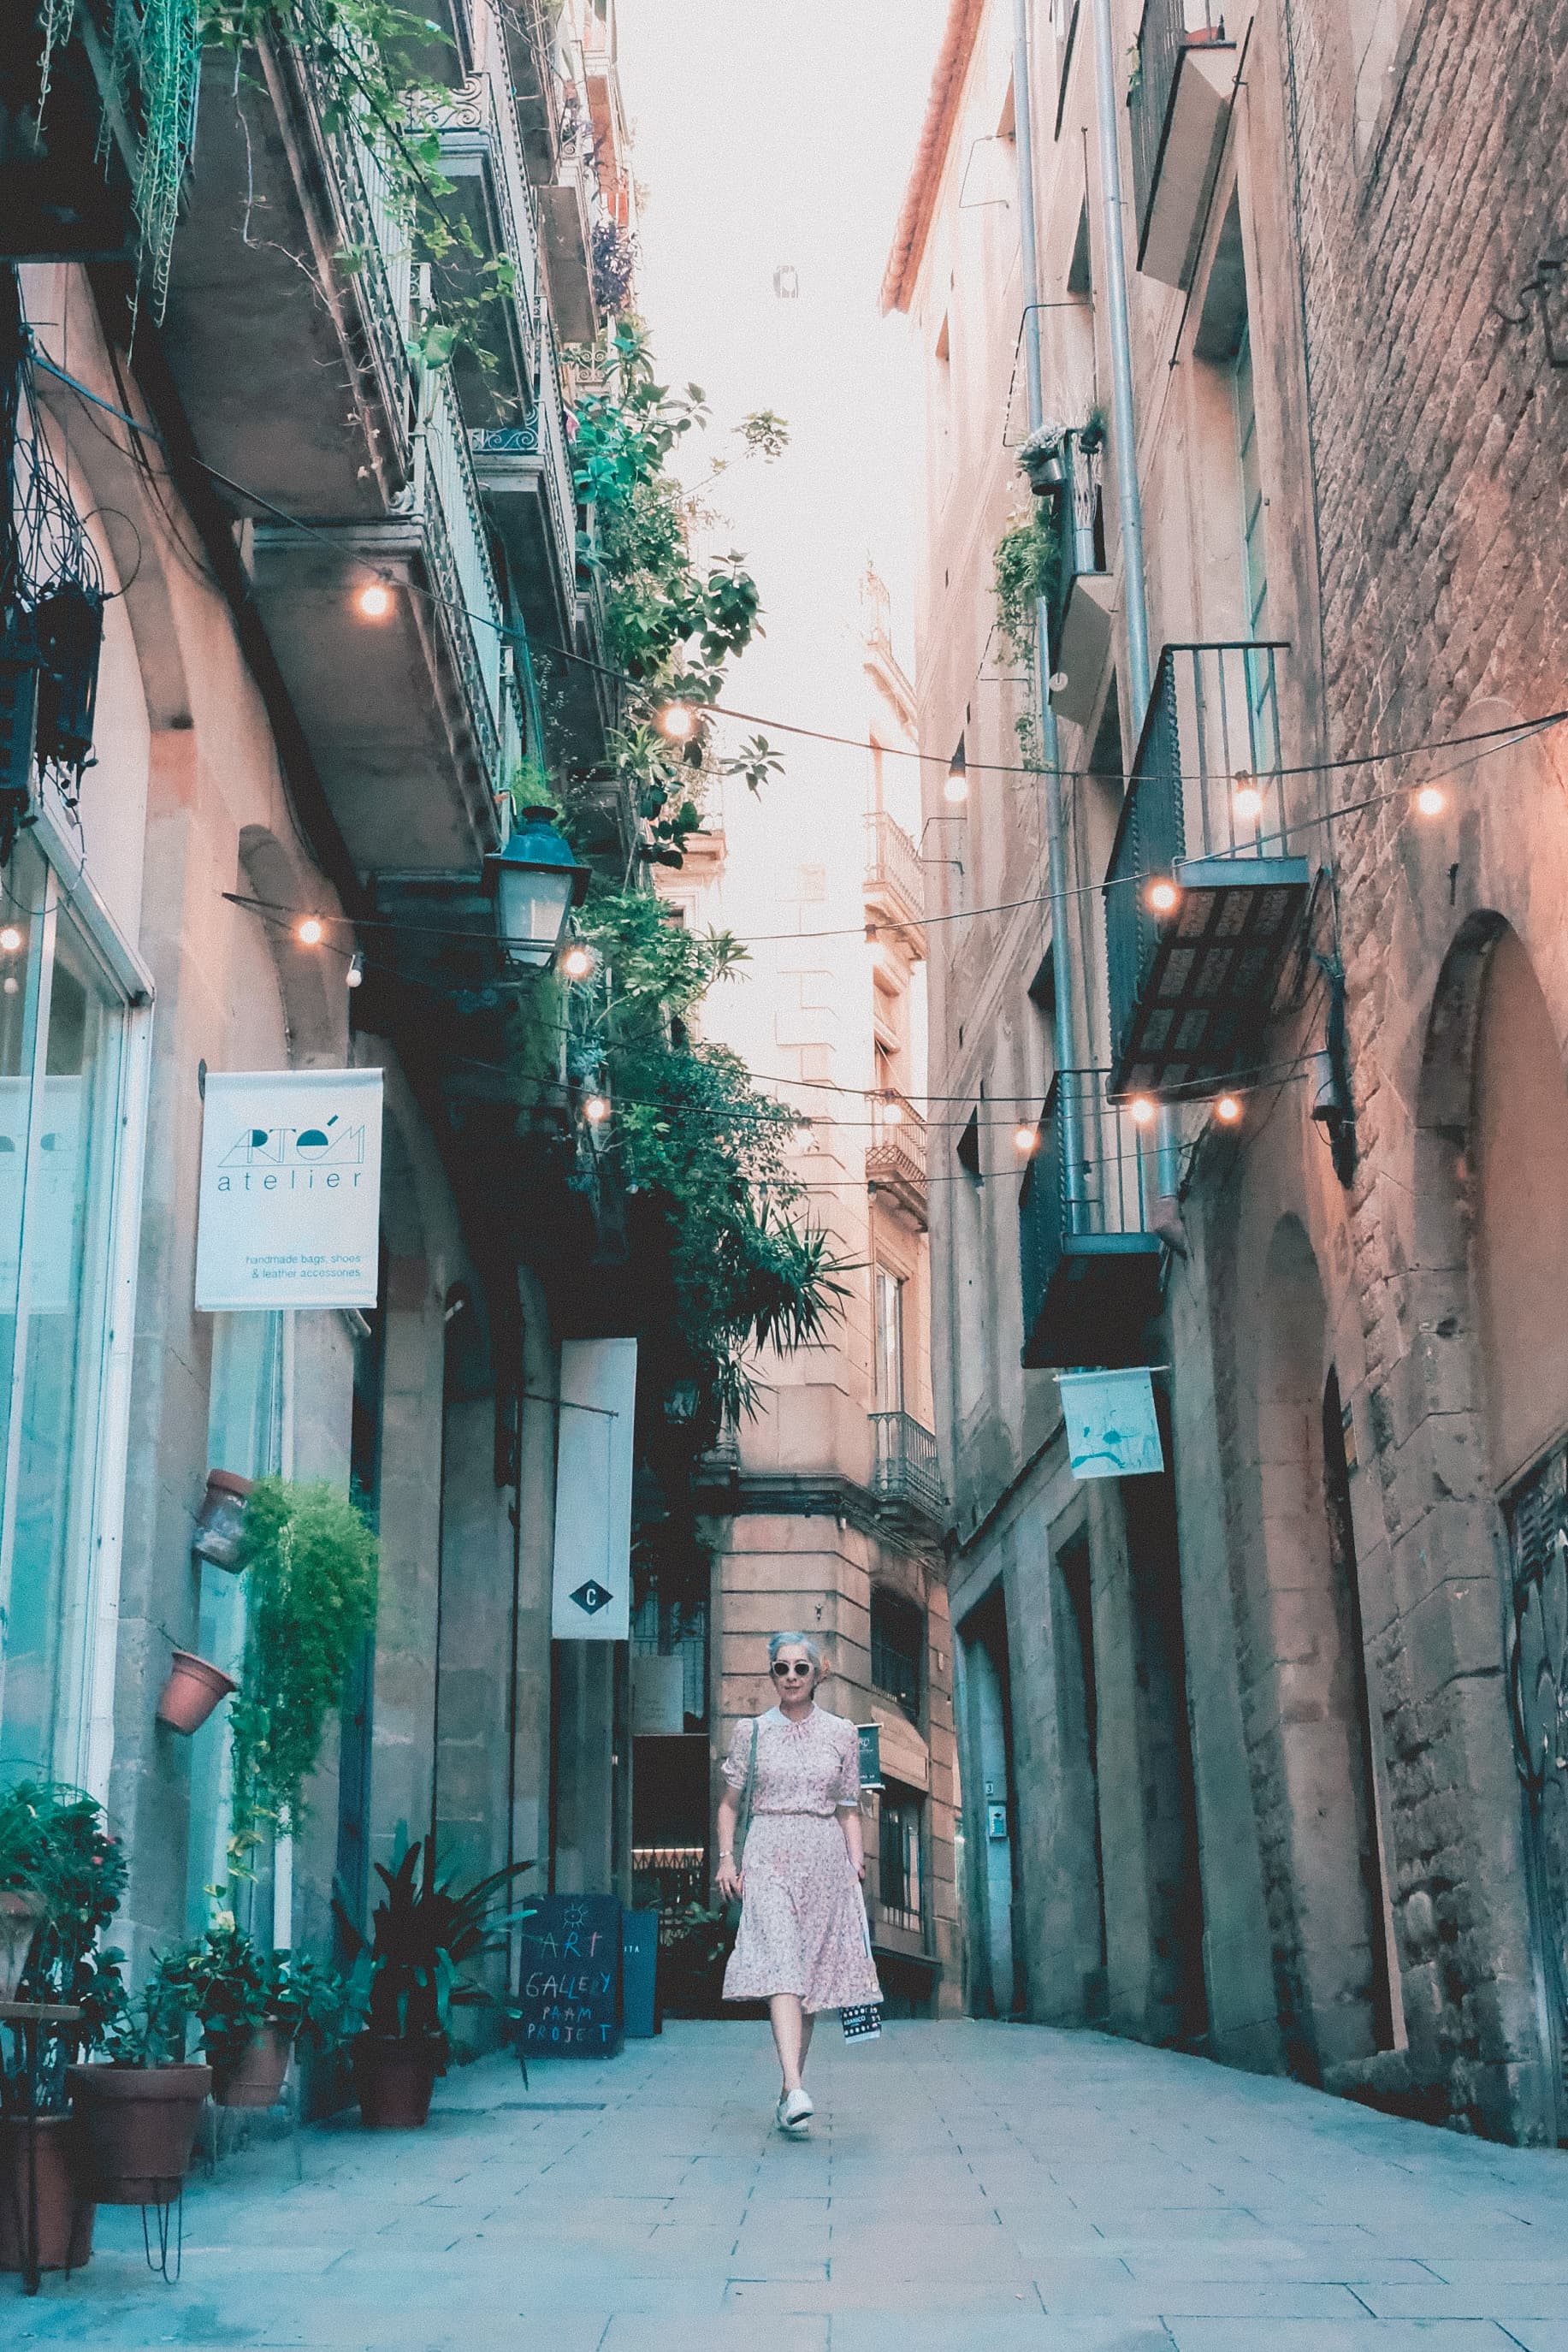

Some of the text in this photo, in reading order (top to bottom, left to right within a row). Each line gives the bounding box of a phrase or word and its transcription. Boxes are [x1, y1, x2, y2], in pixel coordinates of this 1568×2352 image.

[217, 1170, 361, 1192] atelier
[246, 1254, 299, 1264] handmade
[331, 1253, 361, 1263] shoes
[251, 1268, 361, 1278] & leather accessories
[586, 1588, 596, 1606] C
[540, 1931, 603, 1958] ART
[542, 2005, 591, 2022] PAAM
